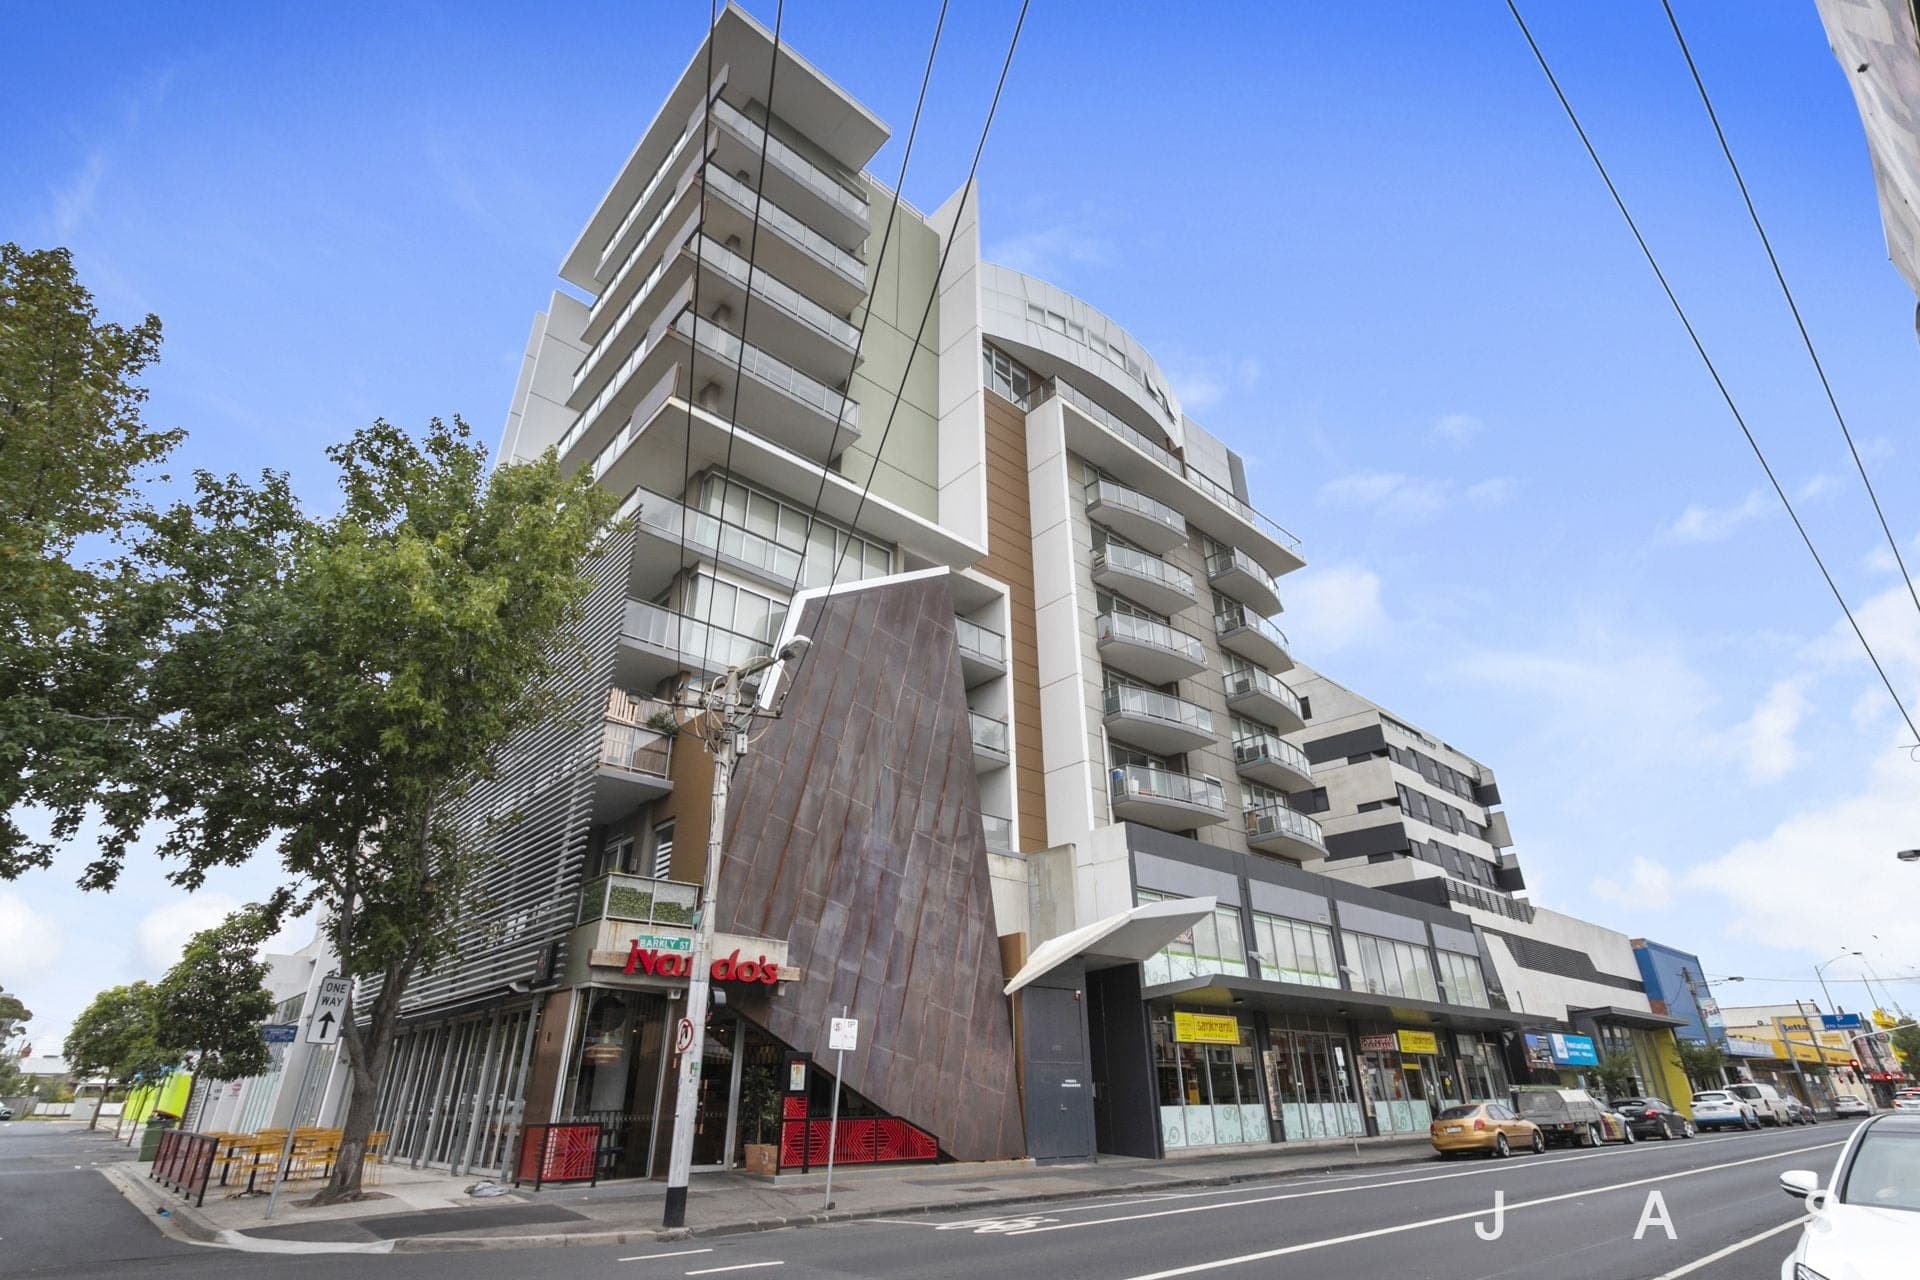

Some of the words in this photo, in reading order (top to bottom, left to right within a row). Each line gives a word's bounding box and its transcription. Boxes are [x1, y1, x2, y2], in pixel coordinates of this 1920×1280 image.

[639, 937, 675, 949] BARKLY
[679, 941, 690, 950] ST
[326, 982, 347, 993] ONE
[321, 996, 343, 1006] WAY
